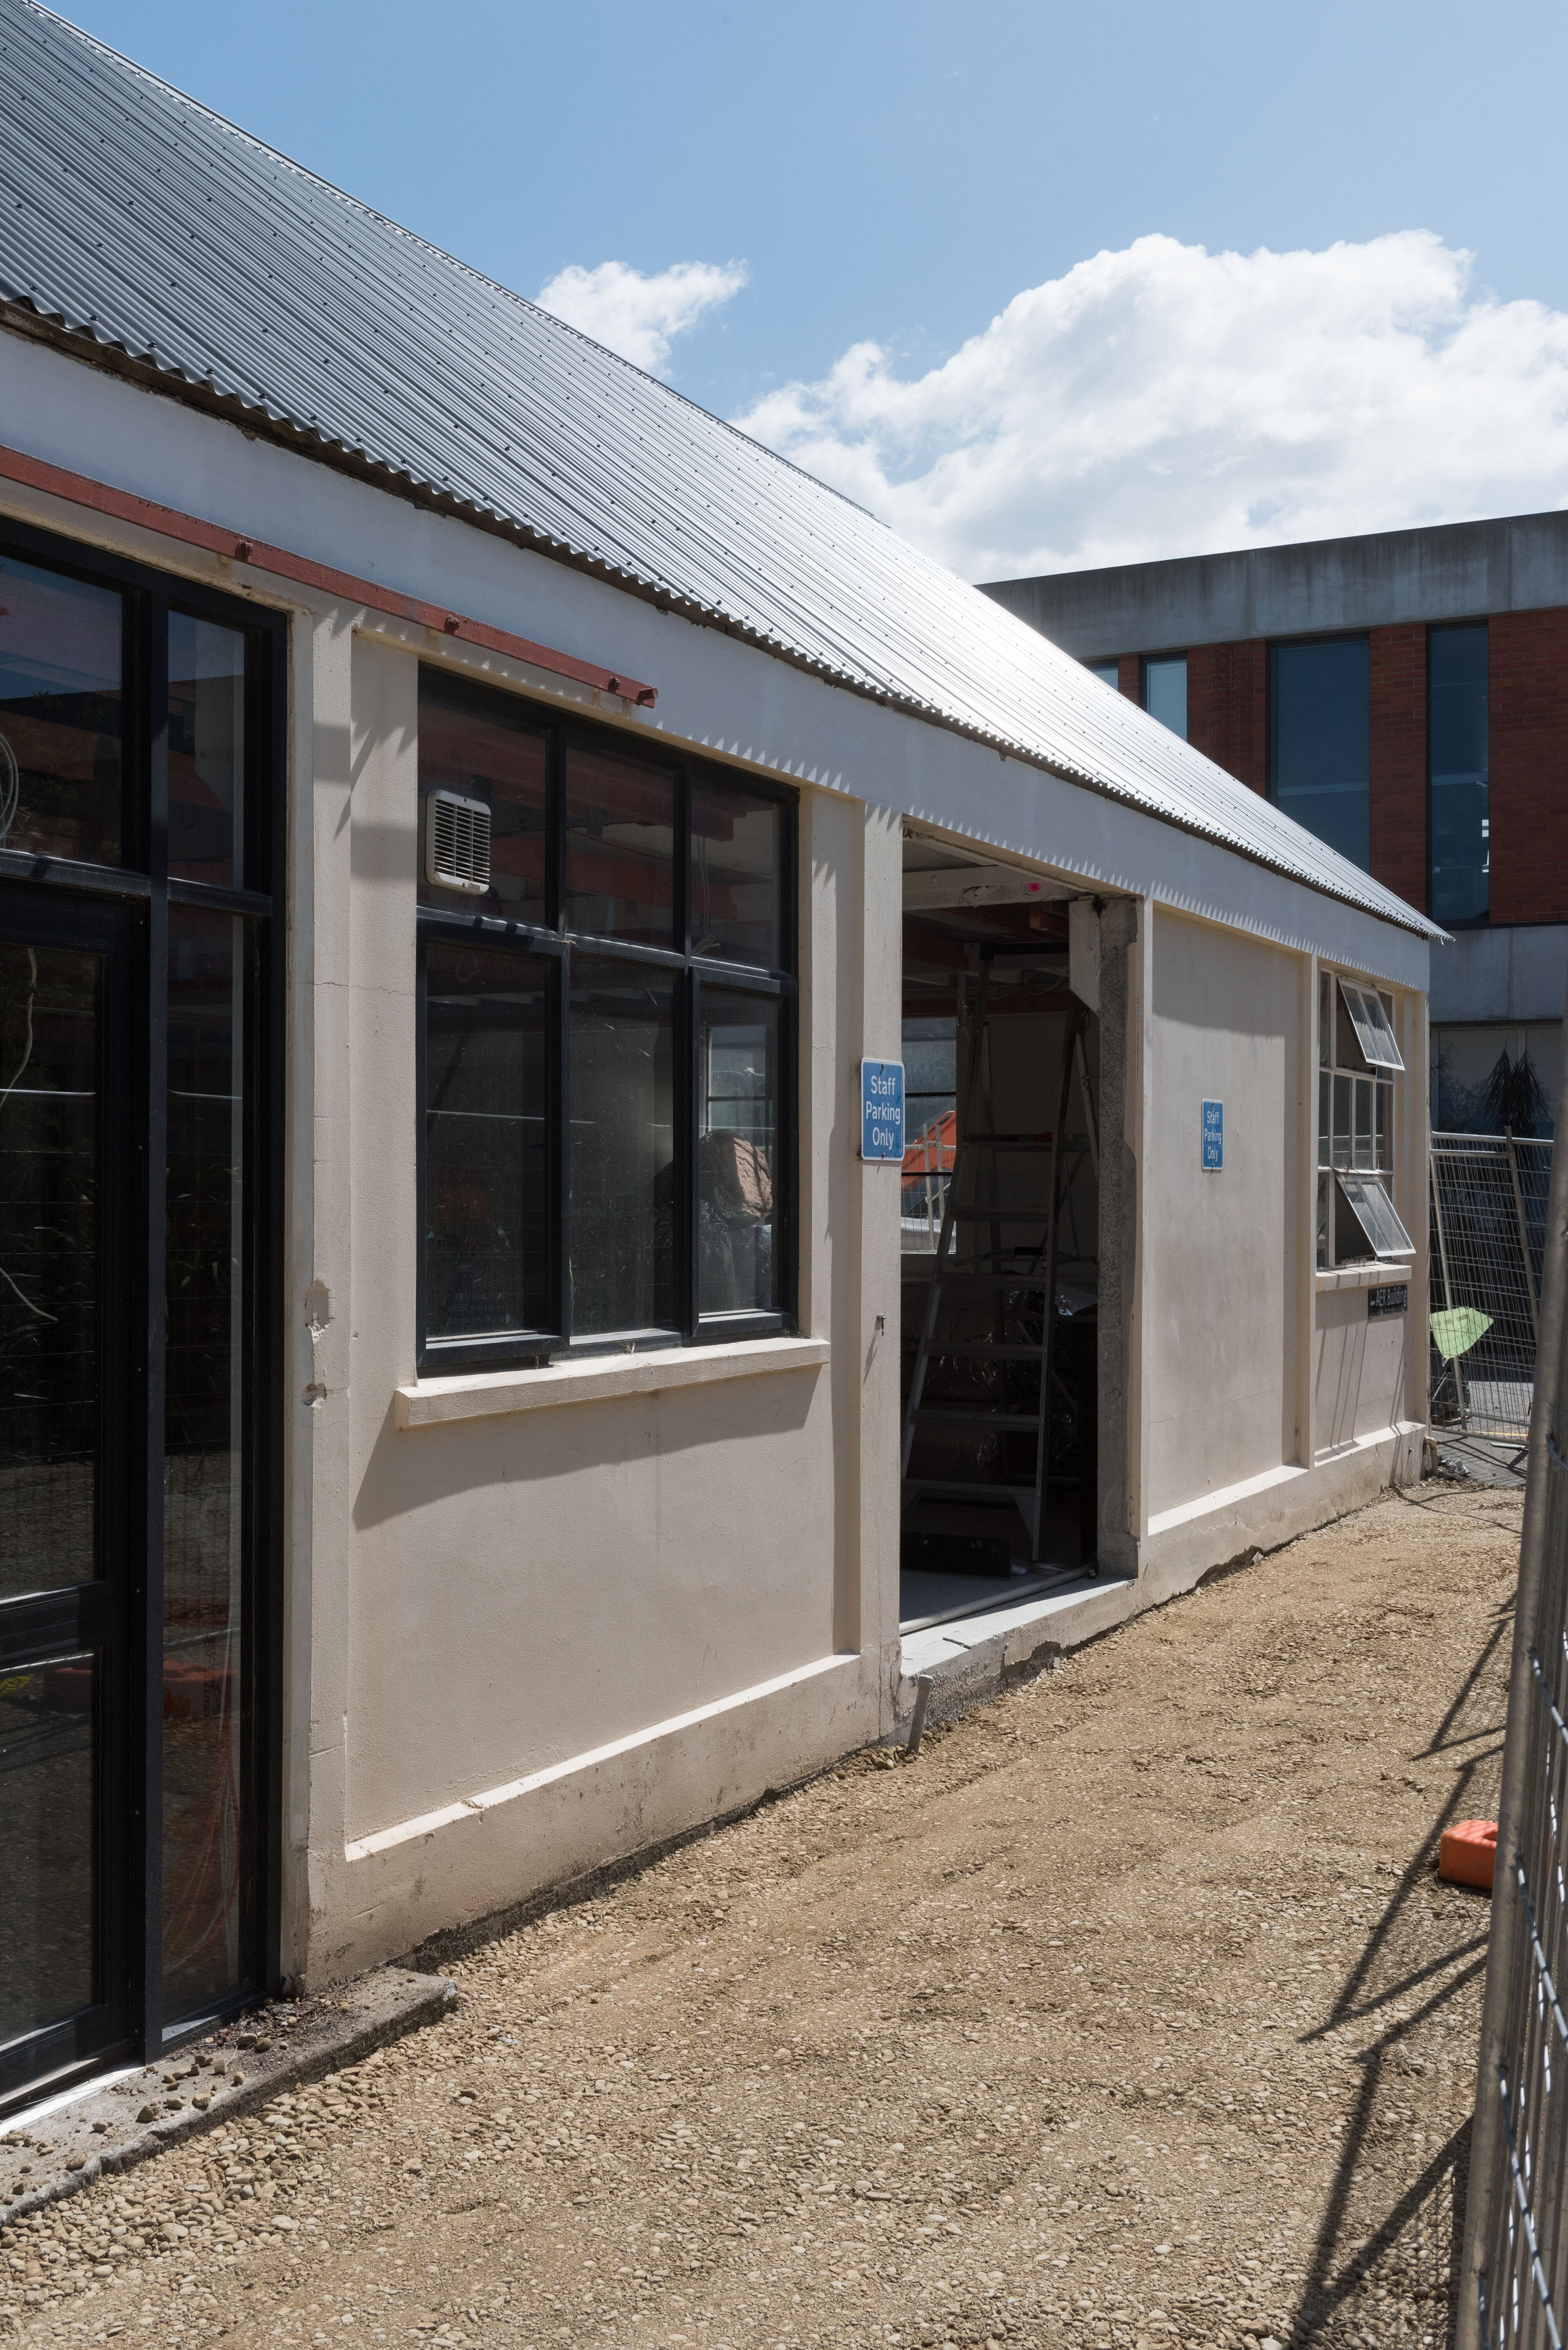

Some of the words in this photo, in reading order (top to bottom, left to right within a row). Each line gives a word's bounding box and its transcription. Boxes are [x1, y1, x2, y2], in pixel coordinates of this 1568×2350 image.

[871, 1075, 895, 1095] Staff
[866, 1101, 900, 1125] Parking
[1207, 1111, 1219, 1124] Staff
[873, 1127, 894, 1150] Only
[1205, 1129, 1221, 1145] Parking
[1207, 1146, 1218, 1162] Only
[1376, 1289, 1387, 1307] AER
[1387, 1286, 1407, 1307] Building
